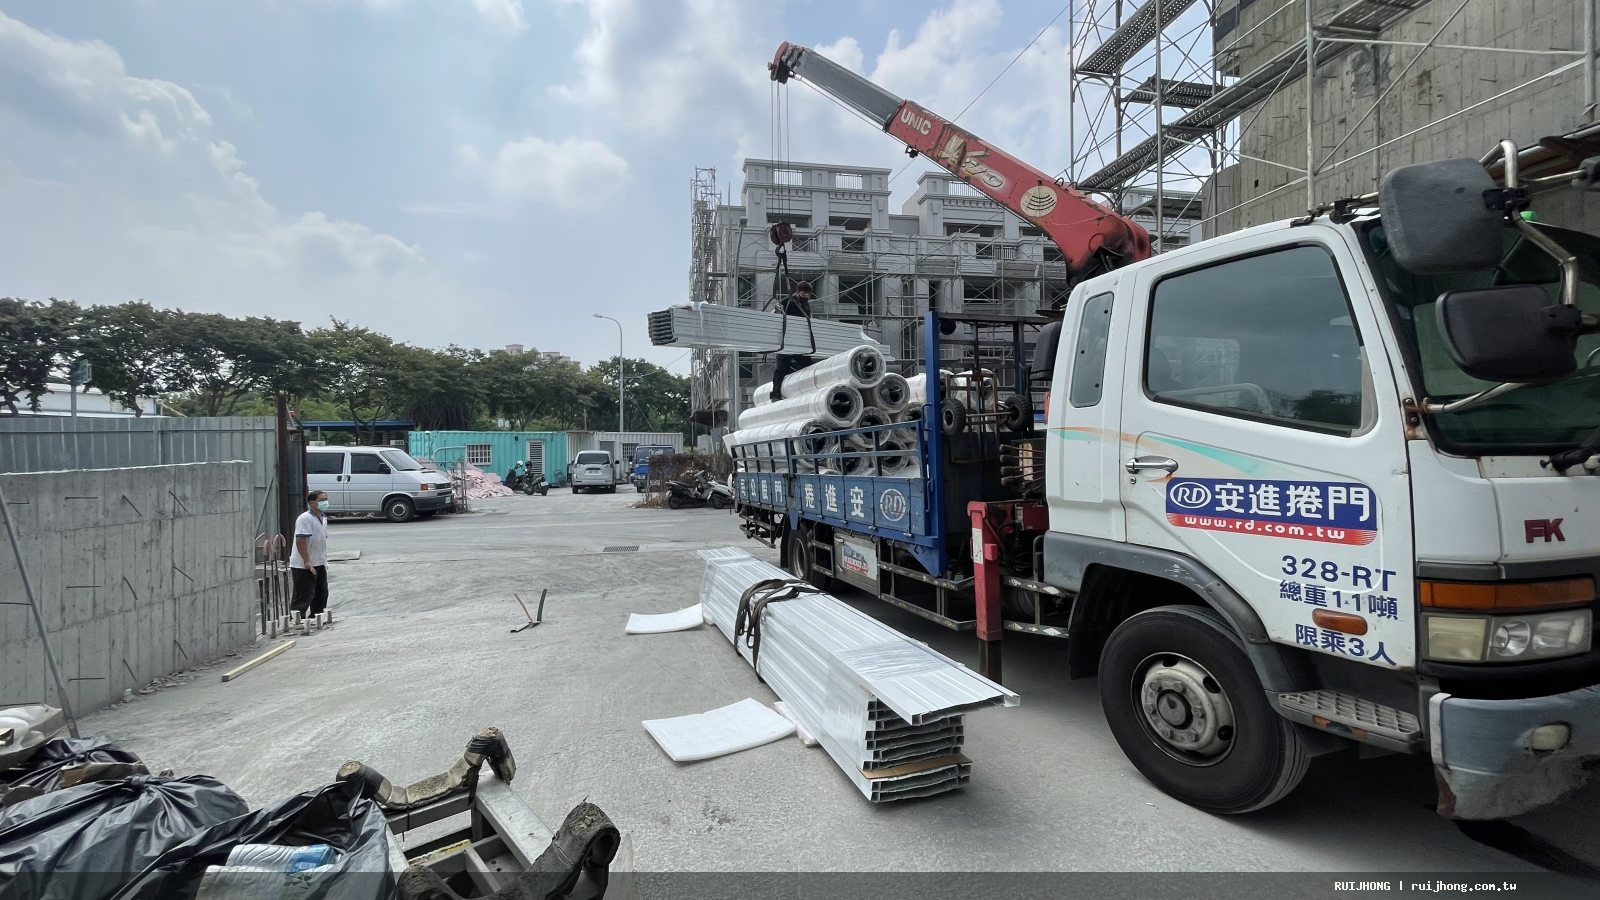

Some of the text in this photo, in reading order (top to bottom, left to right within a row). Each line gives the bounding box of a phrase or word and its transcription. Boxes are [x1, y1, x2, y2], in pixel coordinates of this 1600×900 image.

[901, 108, 932, 135] UNIC
[1175, 482, 1370, 522] RD 安進捲門
[1184, 516, 1345, 540] www.rd.com.tw
[1524, 518, 1566, 544] FK
[1281, 555, 1397, 592] 328-RT
[1295, 623, 1397, 666] 限乘3人
